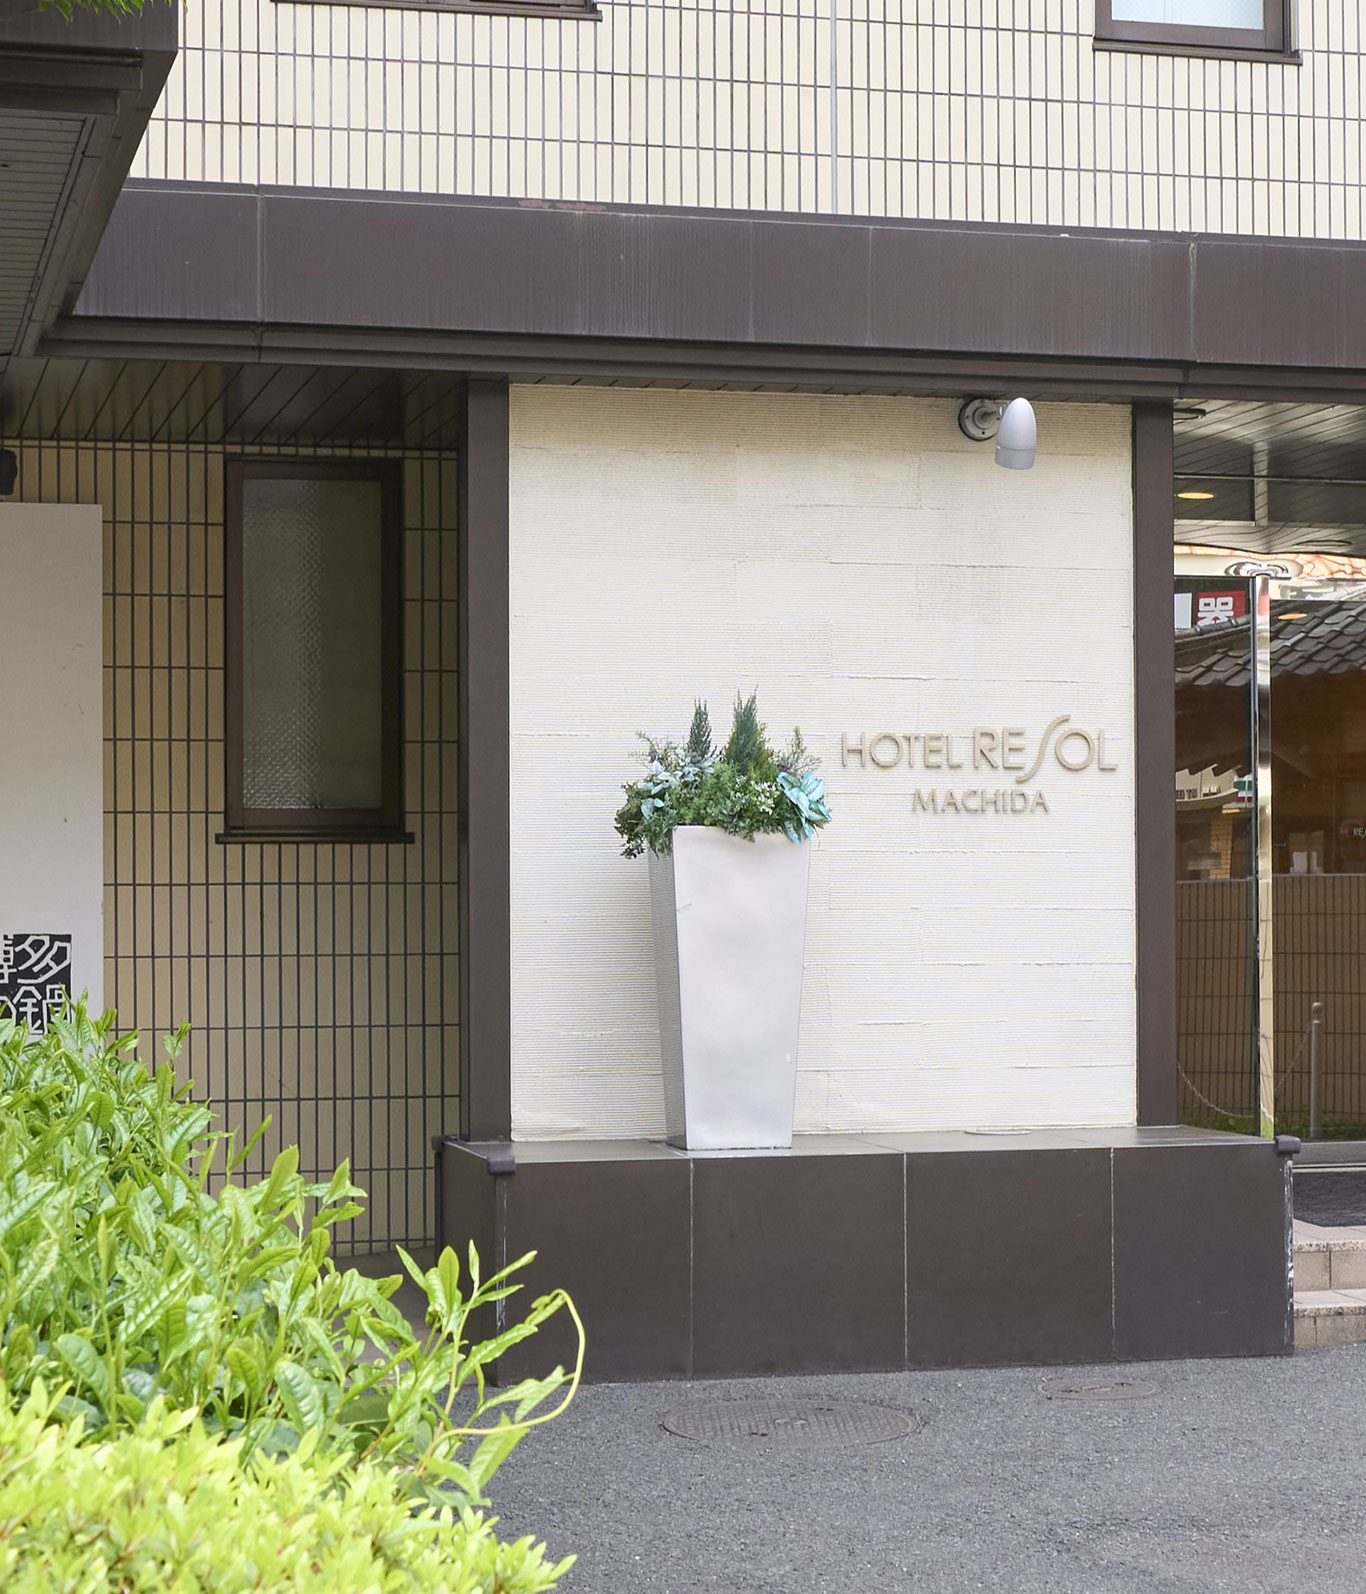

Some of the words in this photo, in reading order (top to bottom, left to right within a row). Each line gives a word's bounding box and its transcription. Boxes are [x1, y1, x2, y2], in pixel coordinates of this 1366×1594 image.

[841, 731, 963, 769] HOTEL
[973, 714, 1119, 784] RESOL
[912, 788, 1050, 814] MACHIDA
